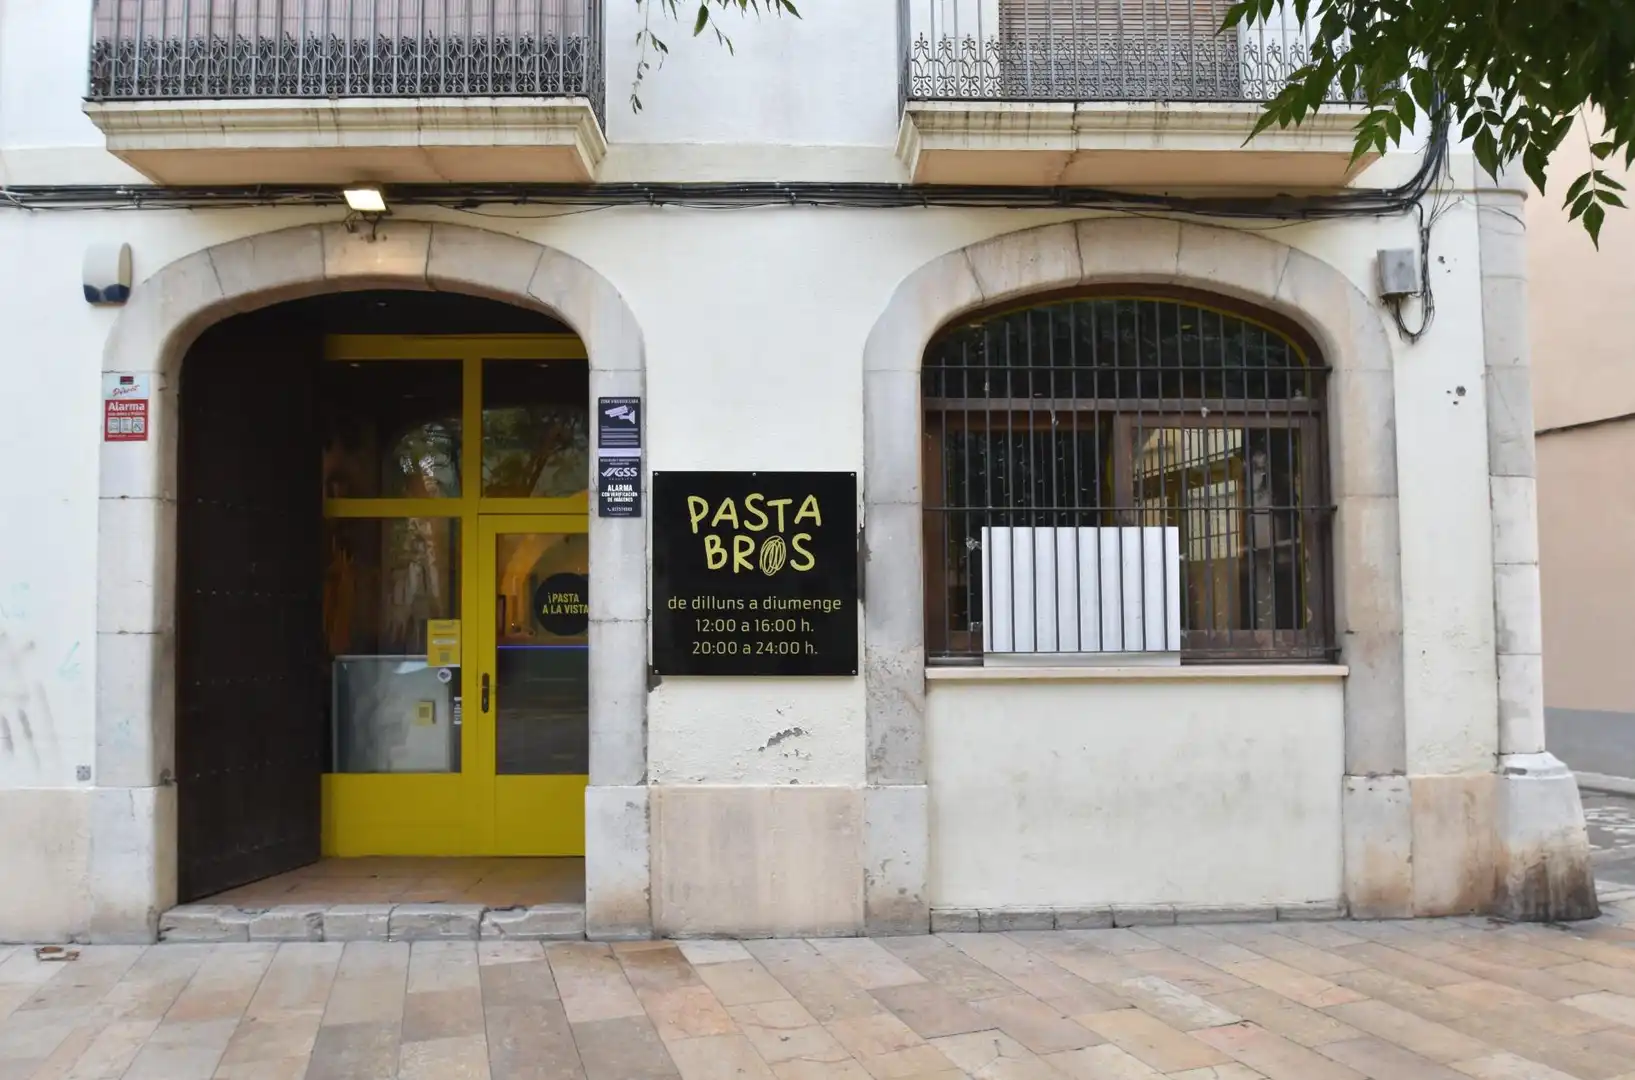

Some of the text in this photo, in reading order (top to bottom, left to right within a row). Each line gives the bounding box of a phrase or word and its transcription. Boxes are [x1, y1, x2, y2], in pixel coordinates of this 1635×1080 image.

[108, 401, 145, 411] Alarma
[614, 467, 638, 477] GSS
[607, 484, 633, 492] ALARMA
[687, 493, 822, 534] PASTA
[704, 533, 815, 577] BROS
[542, 604, 549, 614] A
[550, 604, 563, 614] LA
[667, 596, 842, 613] de dilluns a diumenge
[695, 619, 814, 633] 12:00 a 16:00 h.
[692, 641, 818, 655] 20:00 a 24:00 h.
